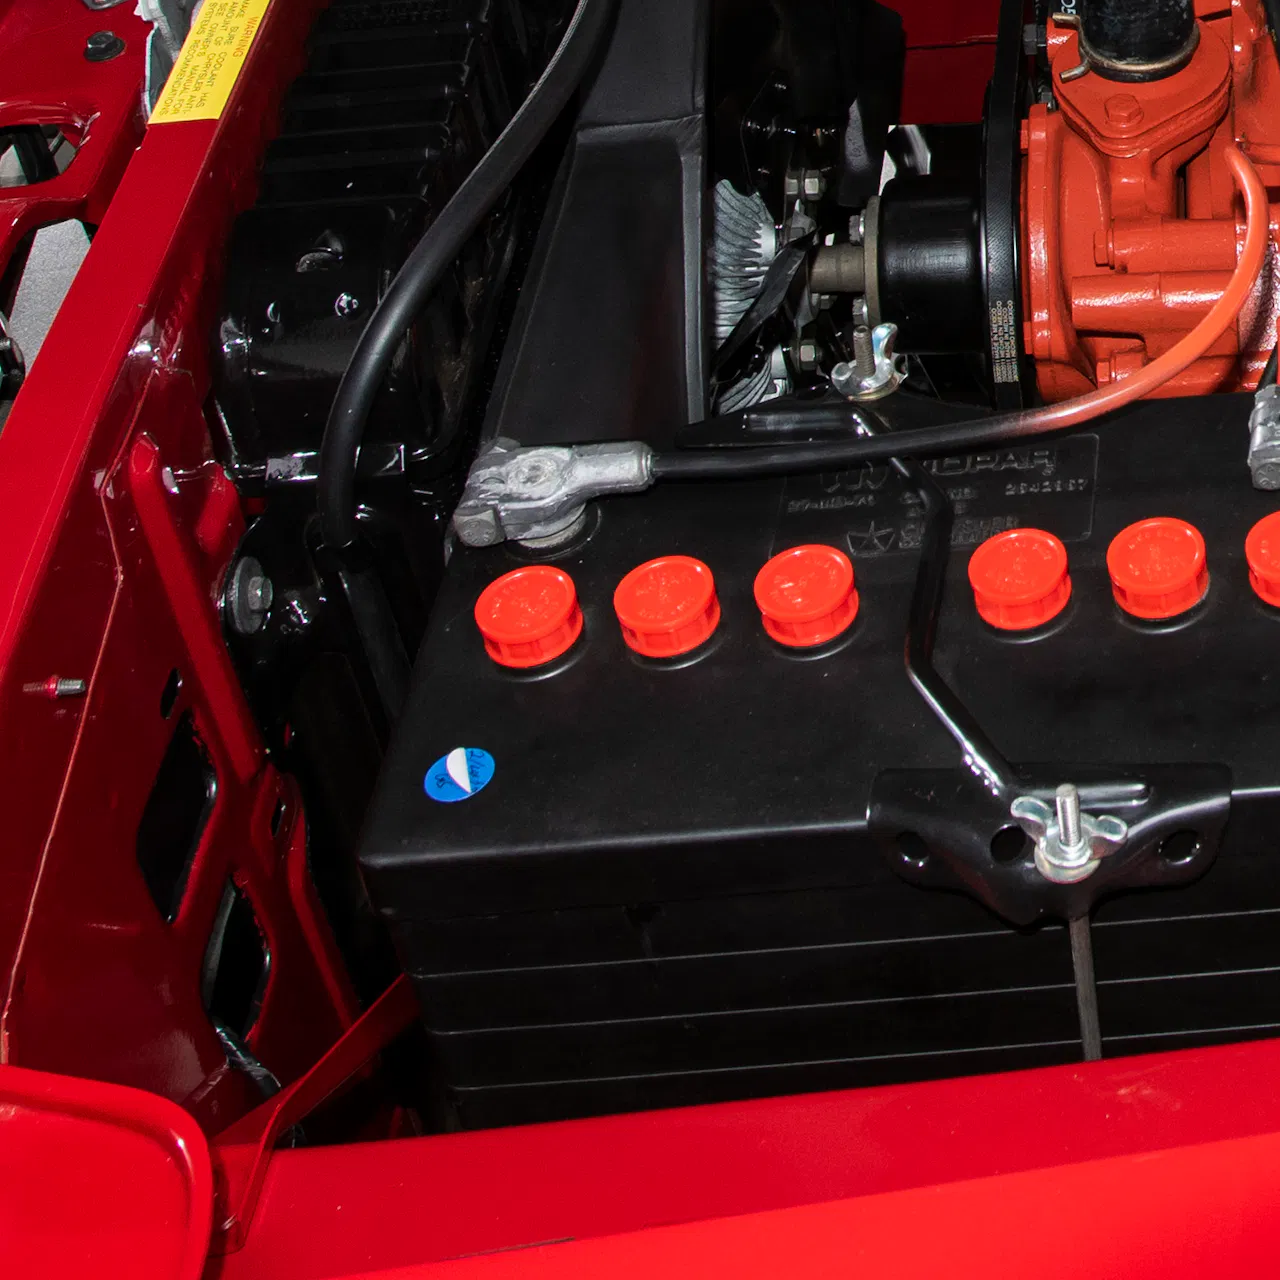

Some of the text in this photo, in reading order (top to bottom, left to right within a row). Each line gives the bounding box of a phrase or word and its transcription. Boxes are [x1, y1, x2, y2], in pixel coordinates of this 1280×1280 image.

[197, 2, 217, 35] SYSTEMS
[215, 3, 228, 16] SEE
[219, 1, 238, 31] AMOUNT
[235, 0, 250, 18] MAKE
[214, 36, 223, 46] OF
[223, 26, 239, 46] SURE
[233, 16, 258, 57] WARNING
[159, 39, 201, 116] RECOMMENDATIONS
[179, 65, 199, 96] MANUAL
[192, 53, 216, 92] CHRYSLER
[207, 52, 227, 87] COOLANT
[171, 99, 185, 115] FOR
[195, 92, 208, 107] HAS
